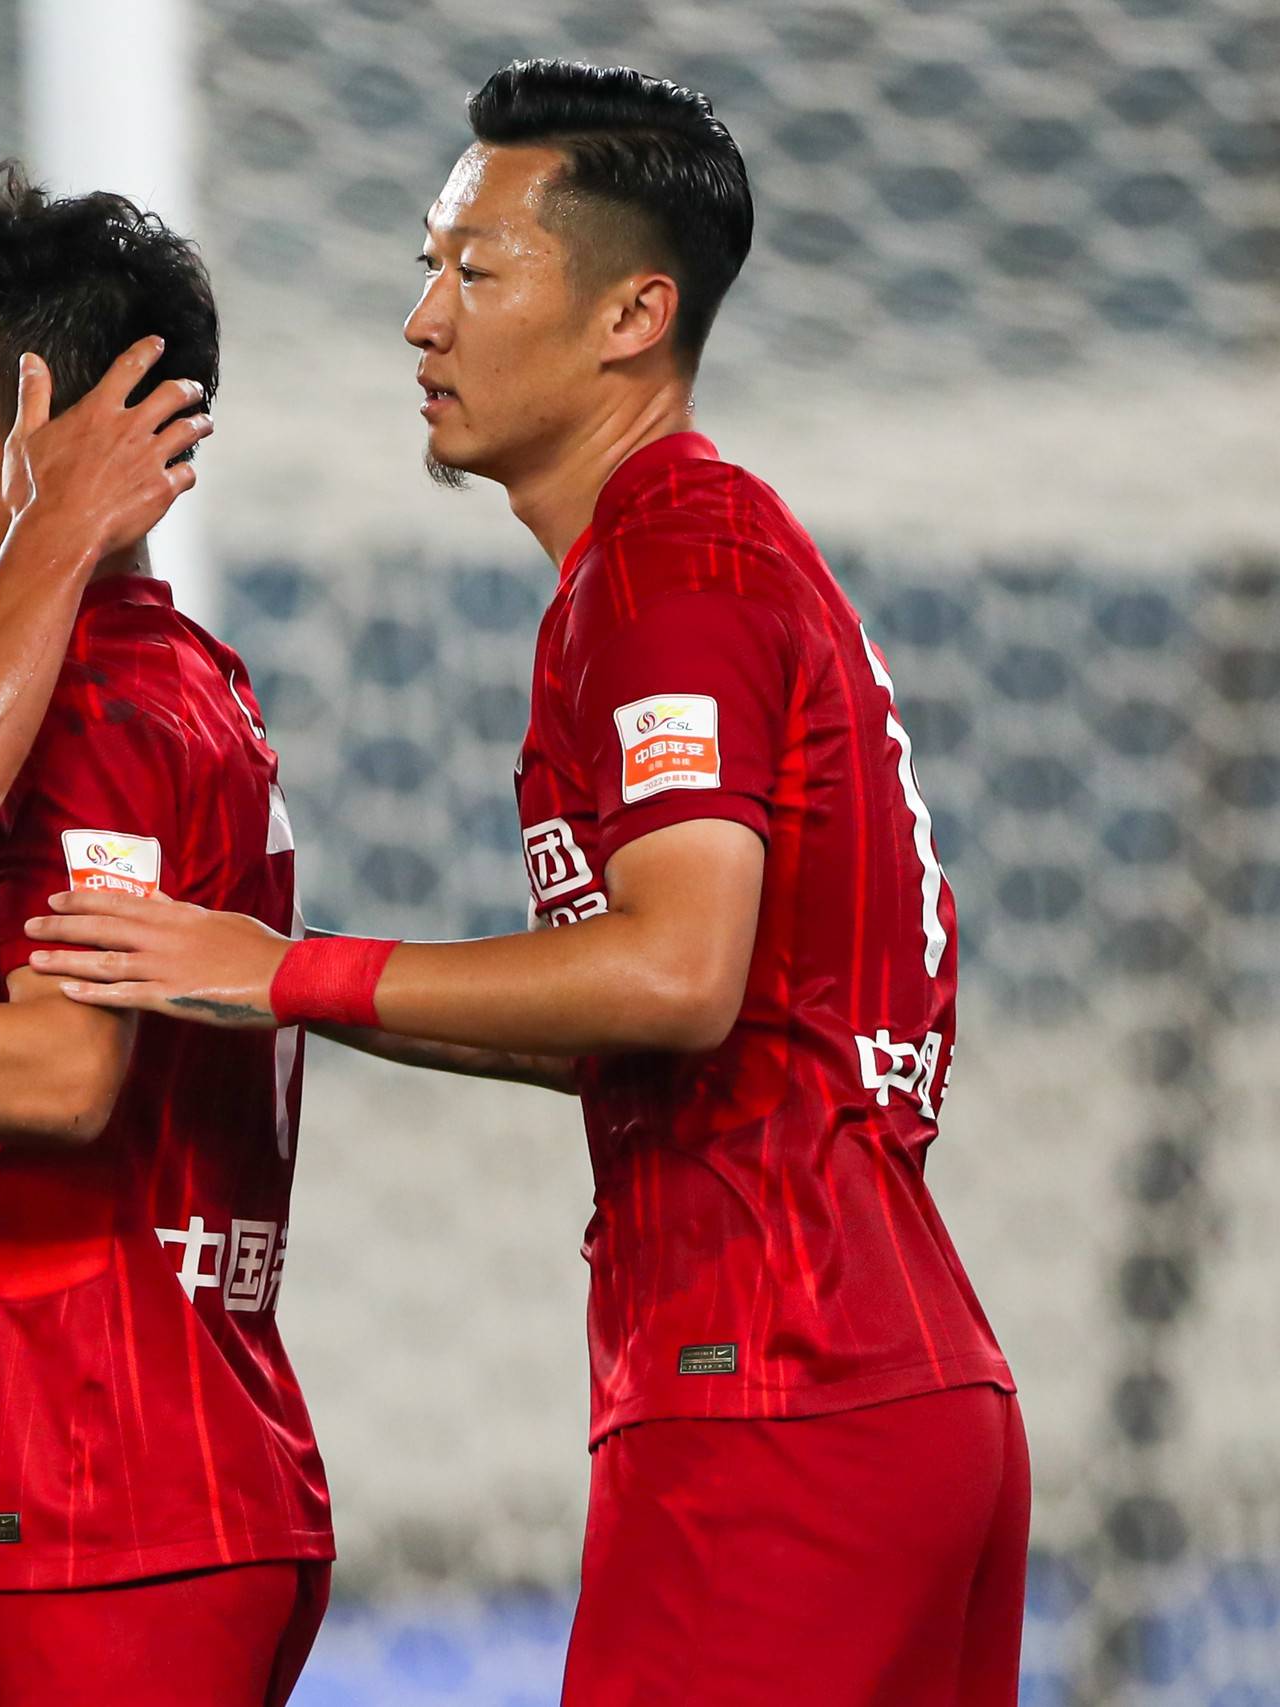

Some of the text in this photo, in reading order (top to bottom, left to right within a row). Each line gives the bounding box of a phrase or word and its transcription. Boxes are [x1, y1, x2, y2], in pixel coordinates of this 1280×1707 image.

[666, 721, 693, 731] CSL
[635, 741, 704, 764] 中国平安
